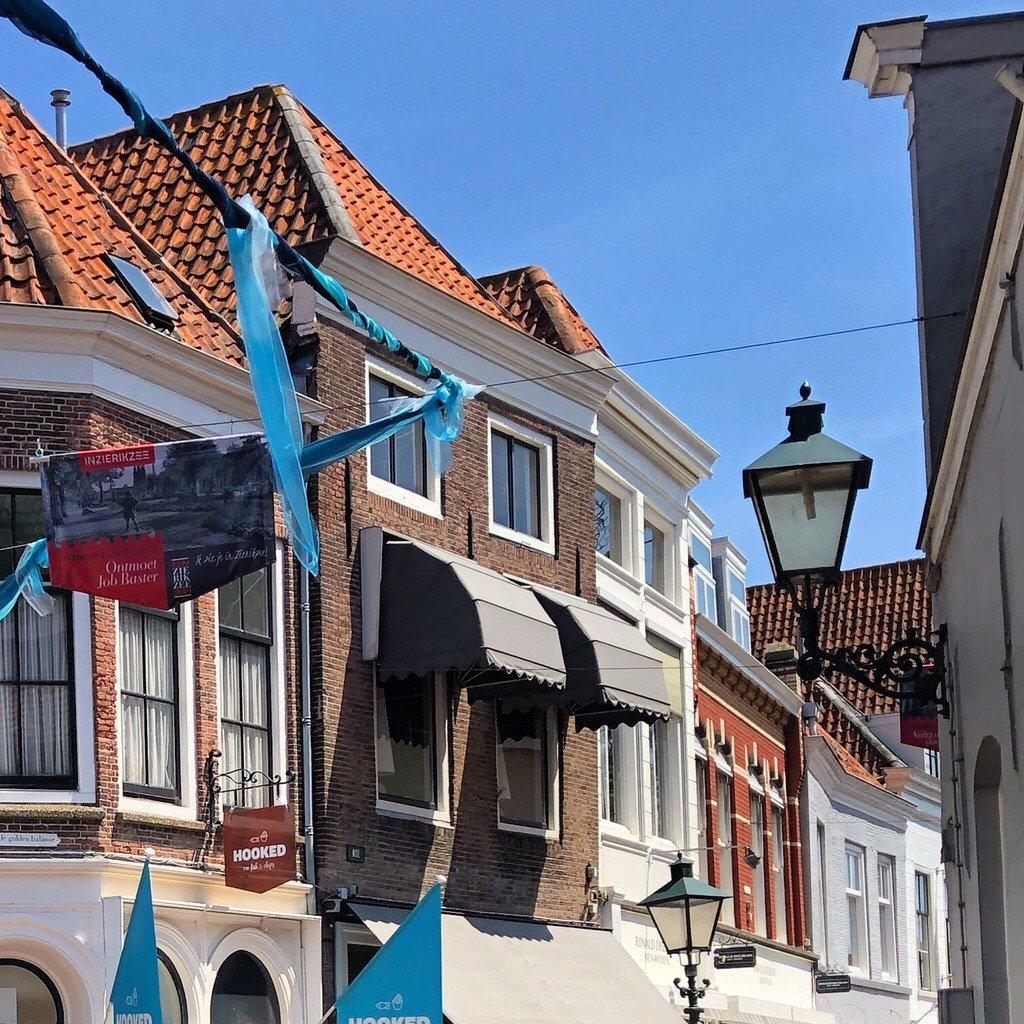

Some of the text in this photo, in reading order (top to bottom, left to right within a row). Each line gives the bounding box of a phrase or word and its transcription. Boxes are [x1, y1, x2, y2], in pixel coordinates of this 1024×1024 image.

[106, 560, 157, 574] Ontmoet
[97, 572, 159, 589] Job Baster
[233, 844, 286, 862] HOOKED
